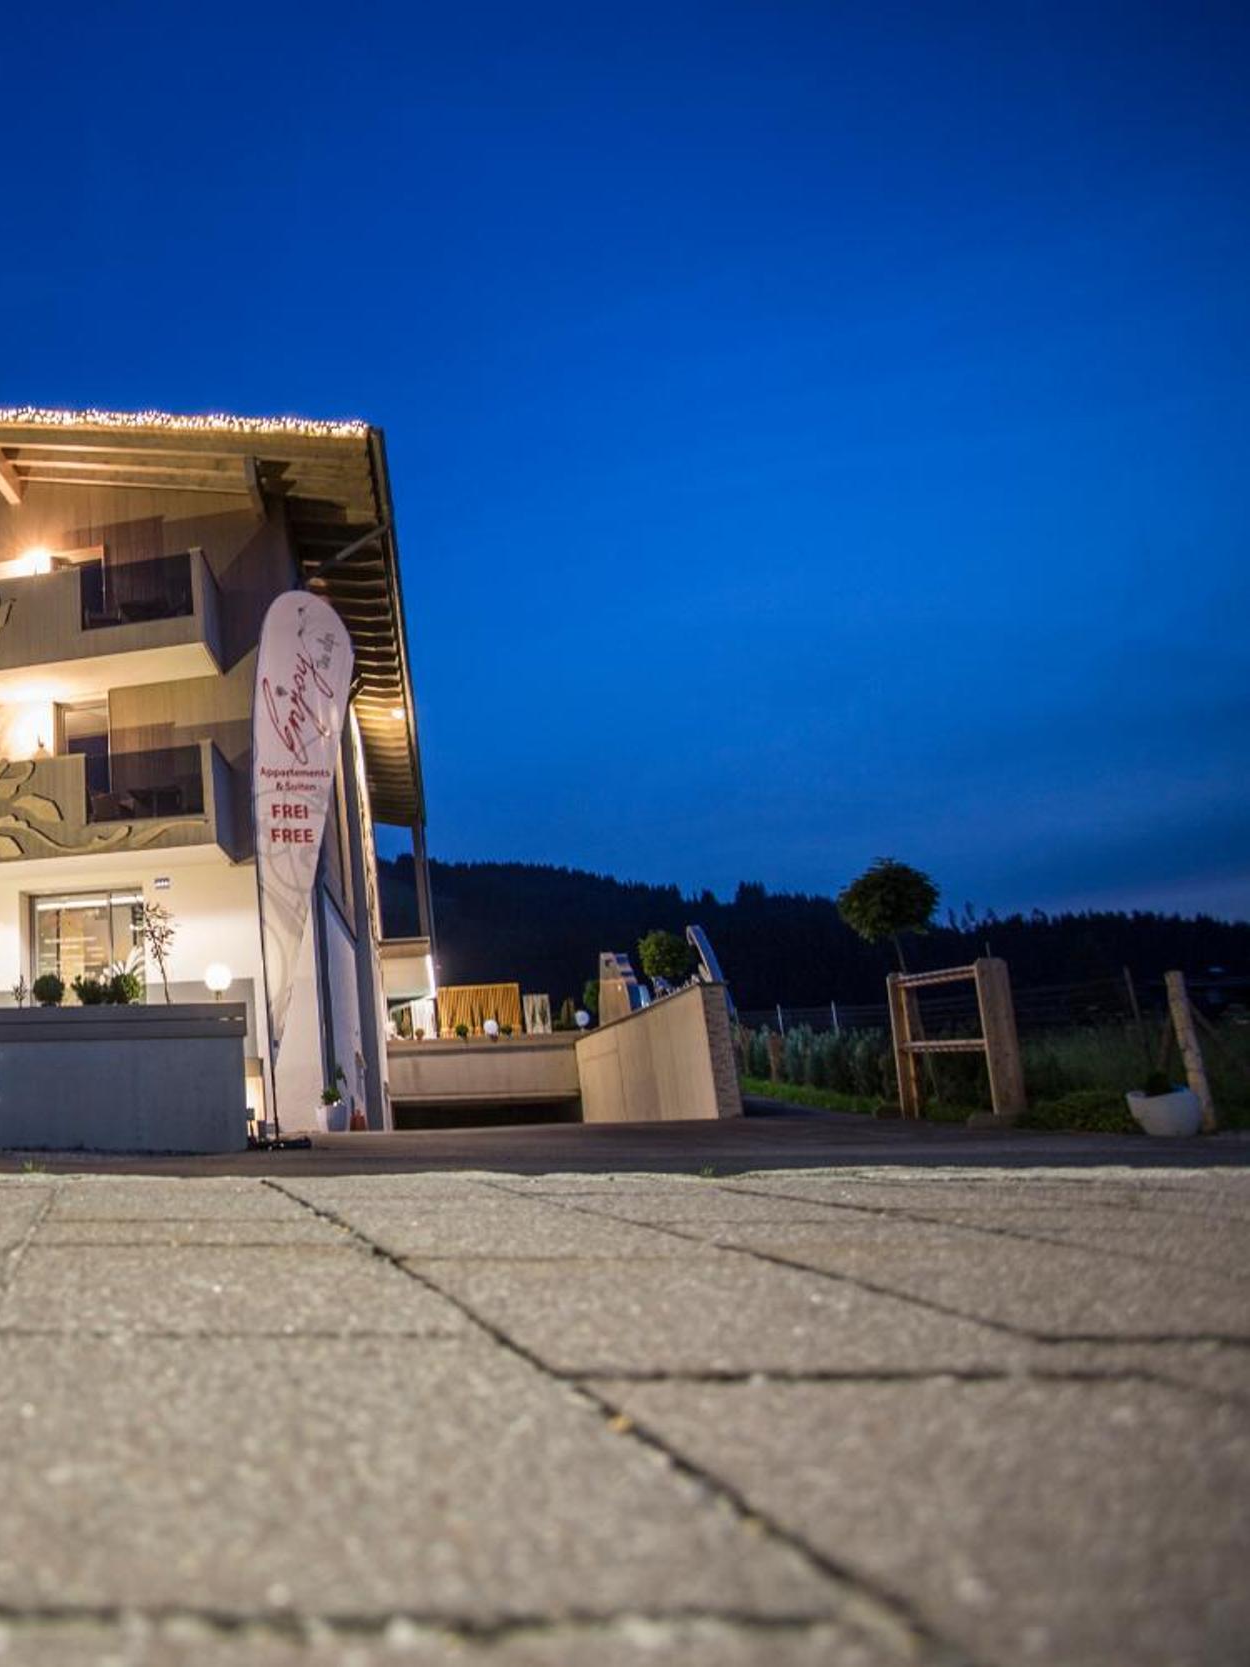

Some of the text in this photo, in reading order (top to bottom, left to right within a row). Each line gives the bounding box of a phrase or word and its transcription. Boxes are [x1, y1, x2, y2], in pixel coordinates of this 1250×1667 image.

[260, 766, 331, 778] Appartements
[271, 804, 308, 819] FREI
[271, 828, 314, 843] FREE
